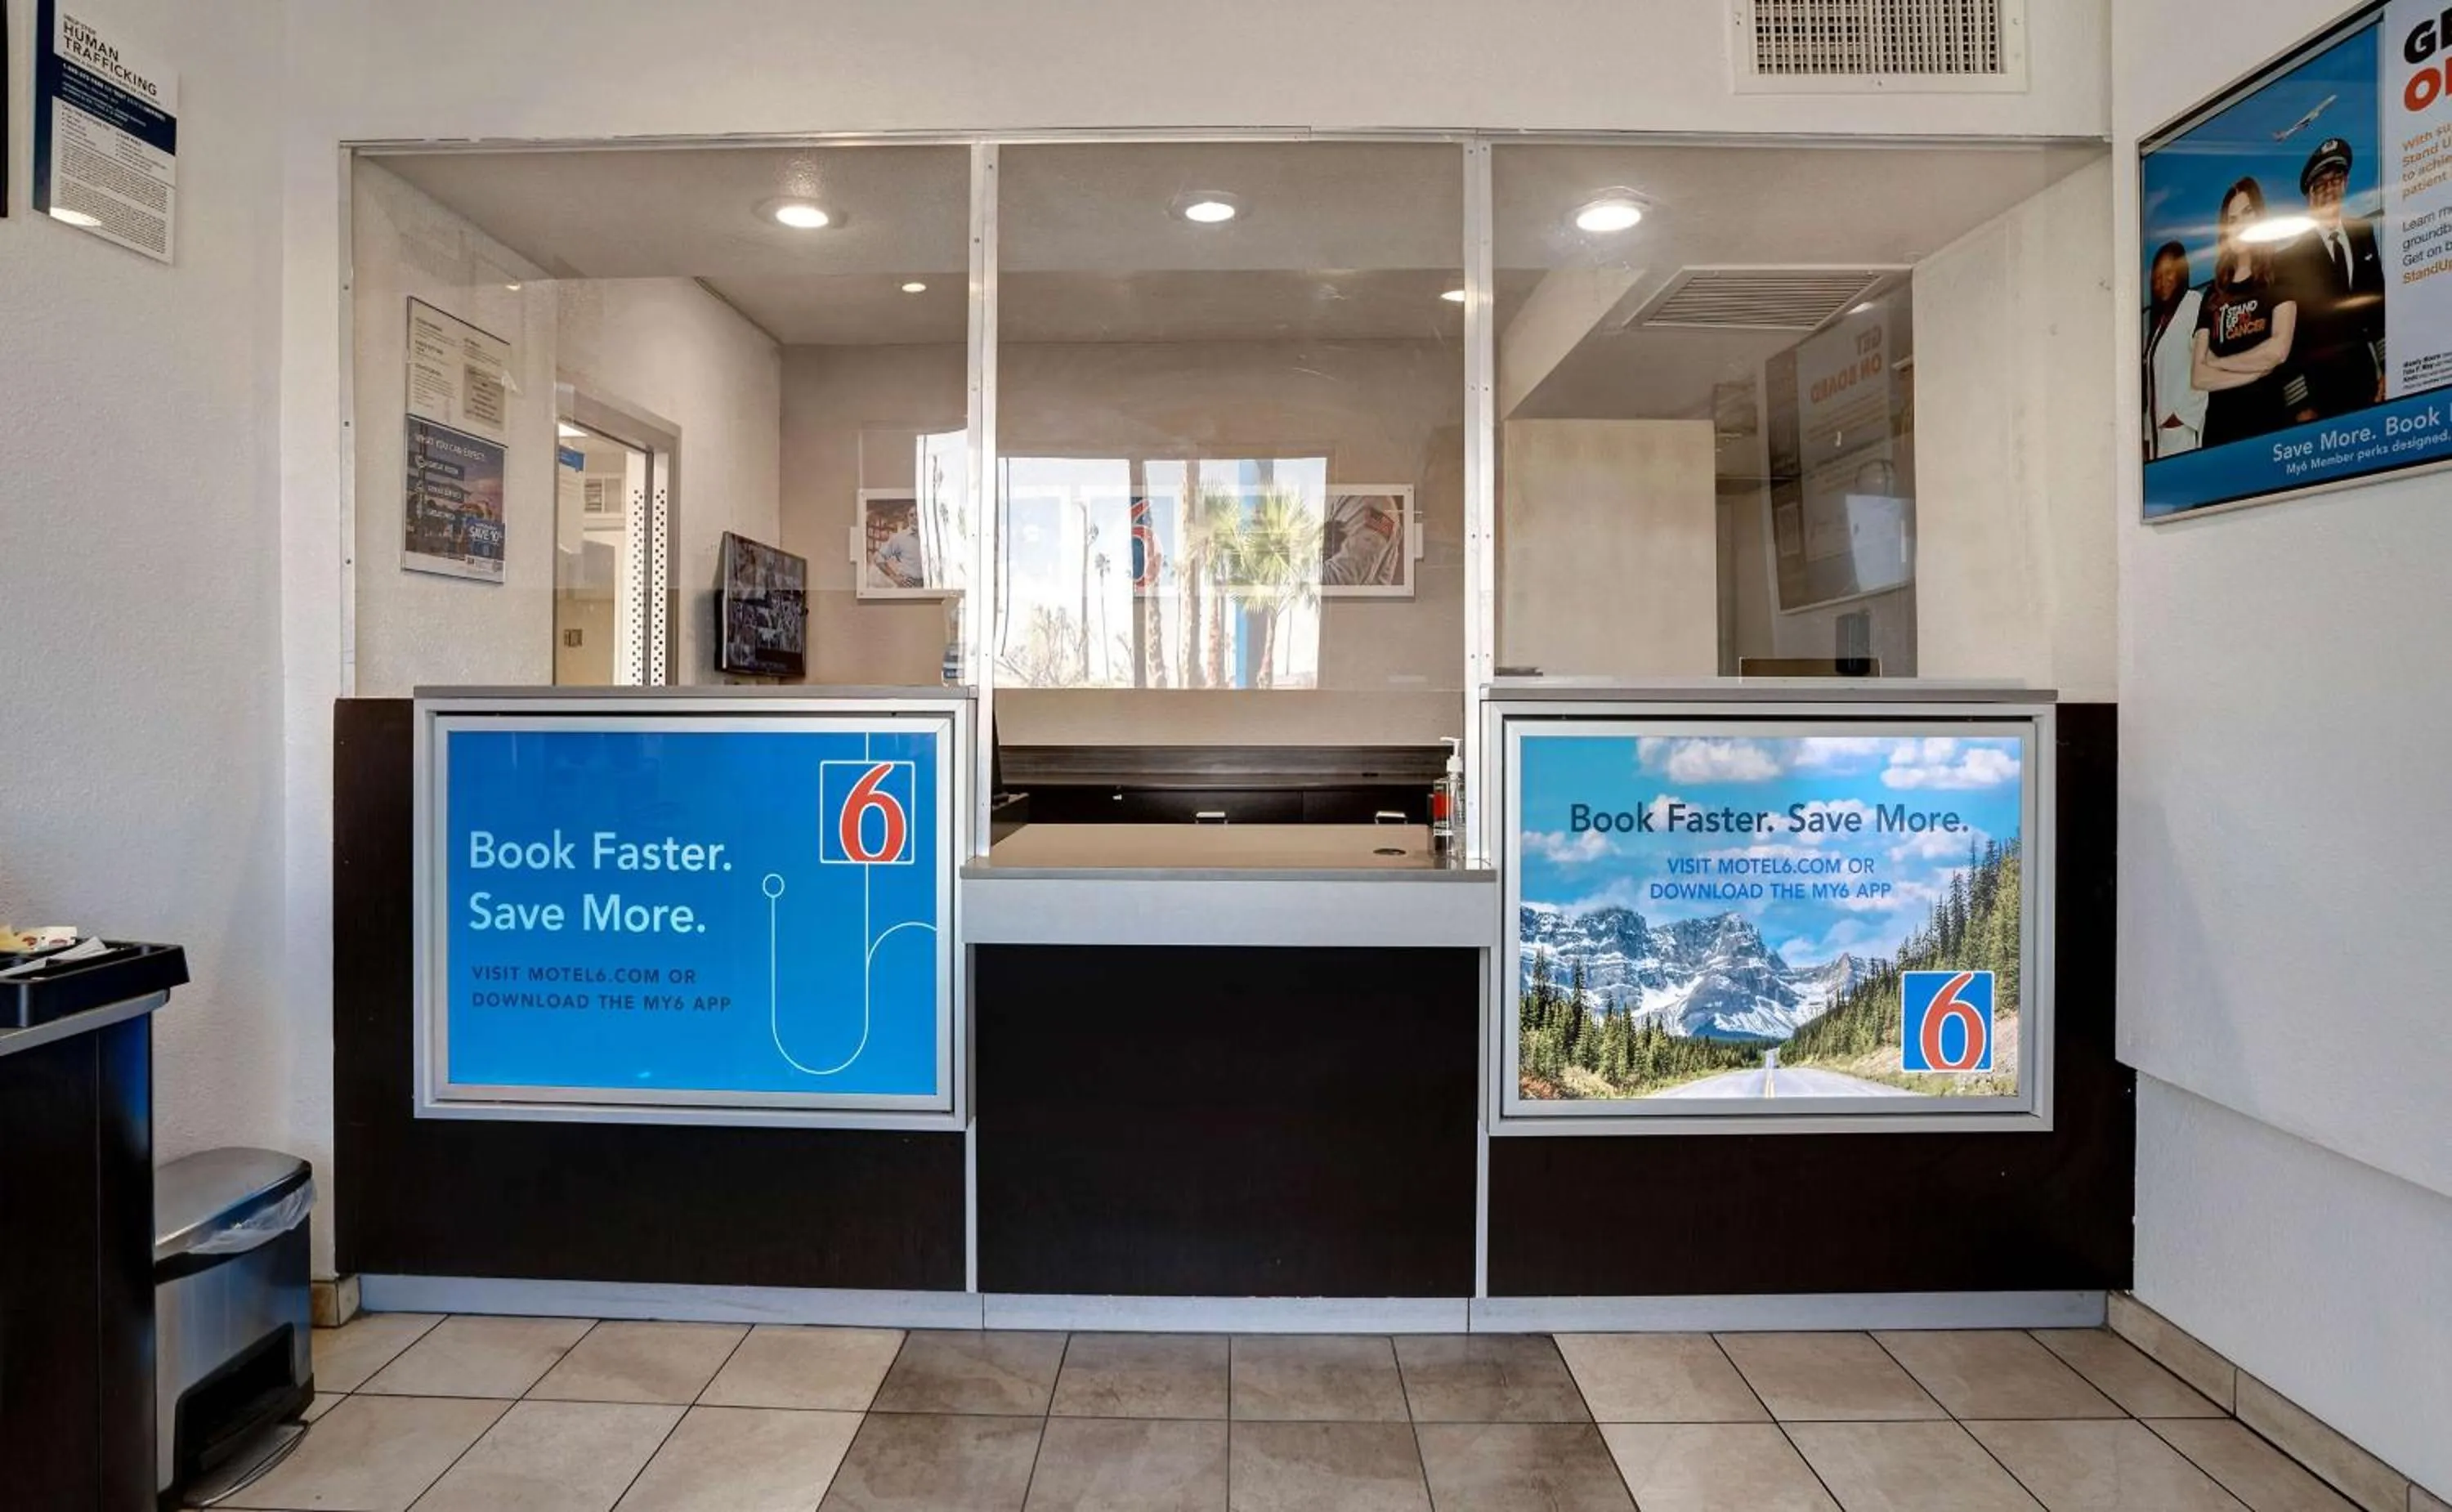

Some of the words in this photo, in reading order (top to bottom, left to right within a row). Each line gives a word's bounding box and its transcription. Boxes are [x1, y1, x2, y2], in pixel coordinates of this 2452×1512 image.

[64, 21, 119, 62] HUMAN
[64, 35, 157, 96] TRAFFICKING
[2404, 56, 2452, 111] O
[2403, 132, 2433, 151] With
[2403, 142, 2439, 167] Stand
[2403, 171, 2415, 181] to
[2403, 172, 2446, 202] patient
[2402, 212, 2435, 232] Learn
[2403, 251, 2423, 266] Get
[2427, 246, 2442, 258] on
[2227, 300, 2258, 317] STAND
[2226, 315, 2239, 329] UP
[2226, 319, 2266, 339] CANCER
[2273, 442, 2313, 463] Save
[2320, 427, 2376, 452] More.
[2386, 405, 2441, 436] Book
[2286, 460, 2307, 476] My6
[2311, 451, 2354, 469] Member
[2357, 444, 2389, 463] perks
[2392, 428, 2451, 452] designed.
[839, 762, 907, 862] 6
[1571, 801, 1655, 833] Book
[1668, 803, 1774, 833] Faster.
[1788, 803, 1863, 833] Save
[1876, 803, 1969, 833] More.
[470, 829, 575, 869] Book
[593, 831, 732, 871] Faster.
[1667, 858, 1711, 874] VISIT
[1718, 858, 1841, 874] MOTEL6.COM
[1848, 858, 1874, 874] OR
[1650, 883, 1763, 899] DOWNLOAD
[1770, 883, 1805, 899] THE
[1812, 883, 1850, 899] MY6
[1856, 883, 1891, 899] APP
[469, 891, 565, 931] Save
[583, 893, 706, 933] More.
[472, 966, 521, 981] VISIT
[529, 967, 660, 984] MOTEL6.COM
[668, 969, 696, 984] OR
[472, 992, 589, 1009] DOWNLOAD
[598, 994, 635, 1009] THE
[643, 995, 685, 1011] MY6
[694, 996, 732, 1012] APP
[1920, 971, 1987, 1071] 6
